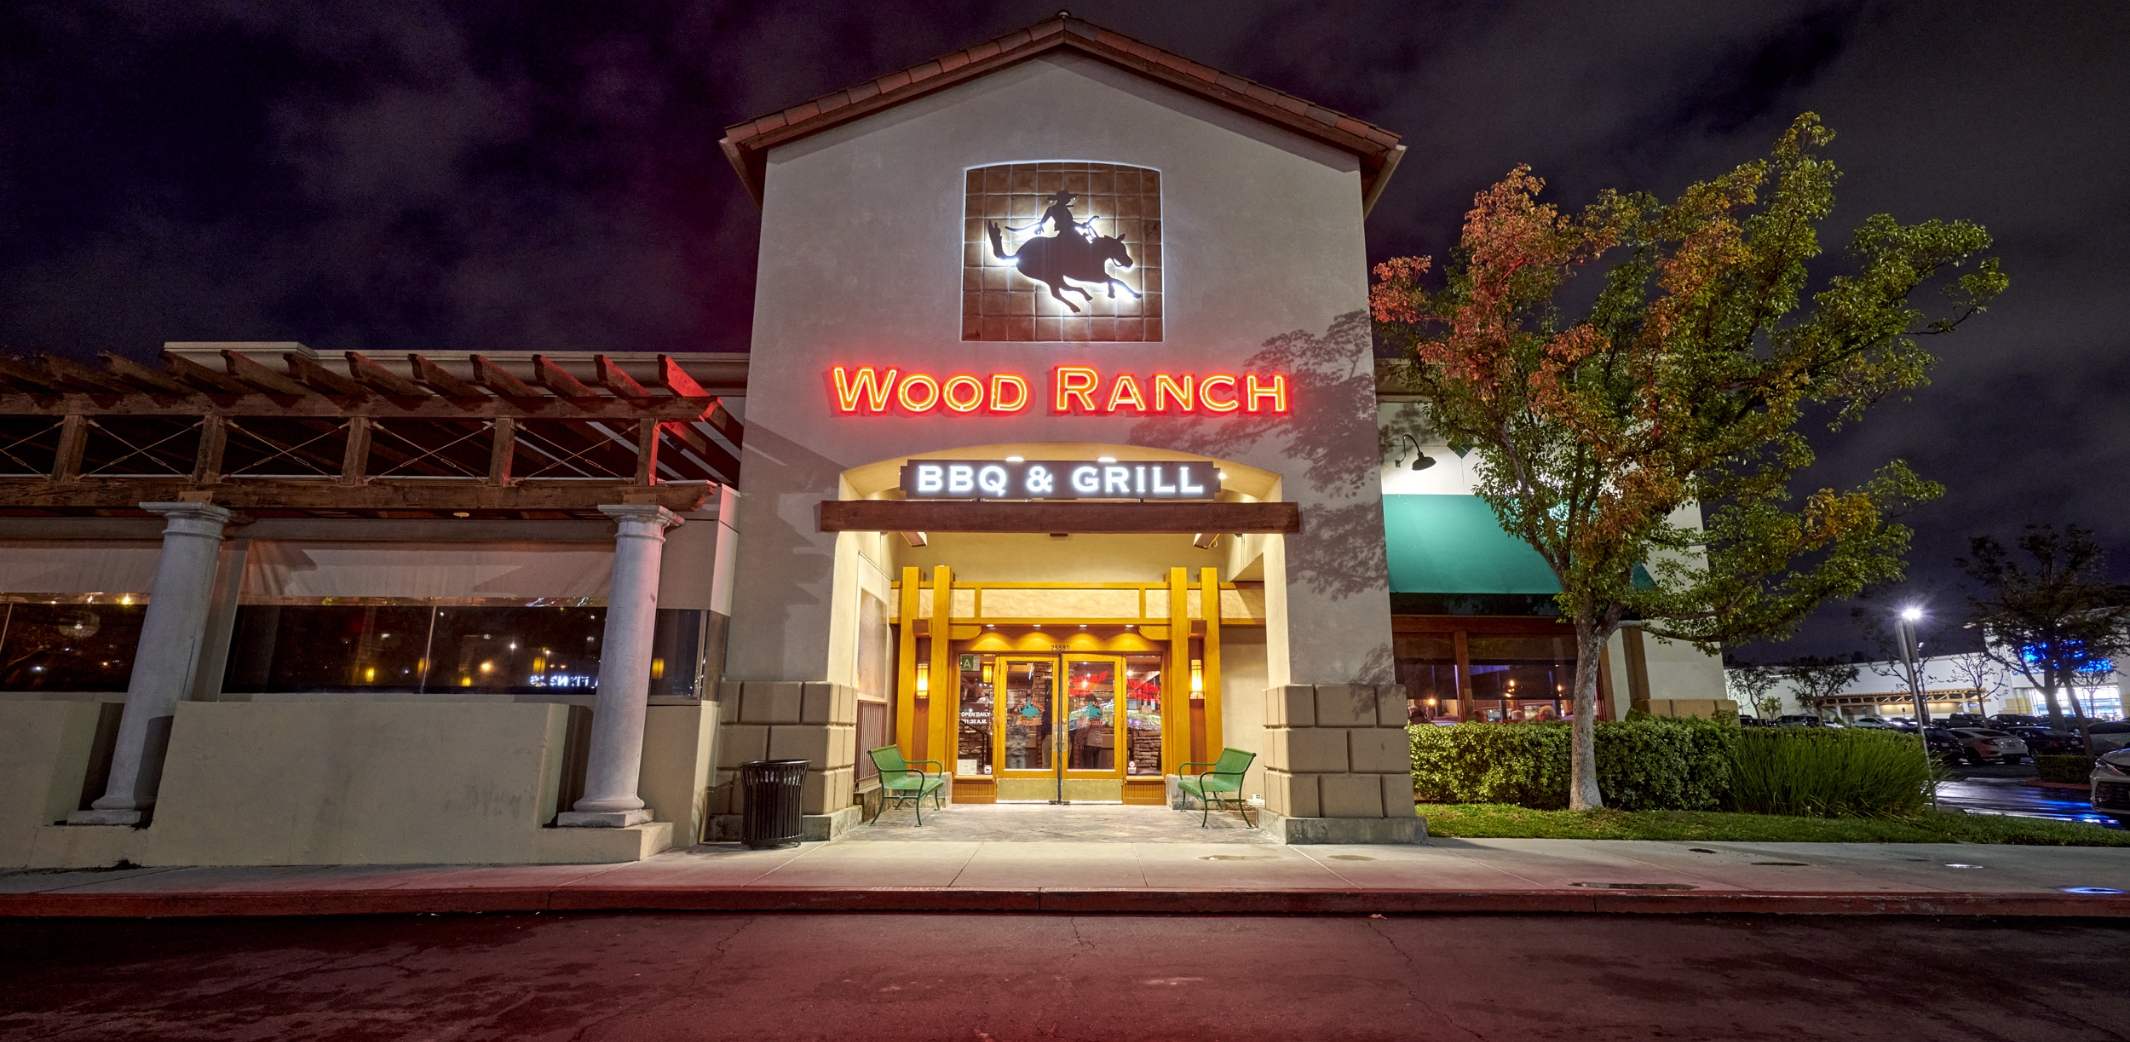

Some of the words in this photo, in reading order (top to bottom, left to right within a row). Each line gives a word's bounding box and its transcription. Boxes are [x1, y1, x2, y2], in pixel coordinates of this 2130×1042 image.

[832, 365, 1028, 413] WOOD
[1055, 365, 1288, 414] RANCH
[916, 465, 1006, 496] BBQ
[1026, 465, 1053, 494] &
[1072, 465, 1204, 495] GRILL
[963, 658, 971, 668] A
